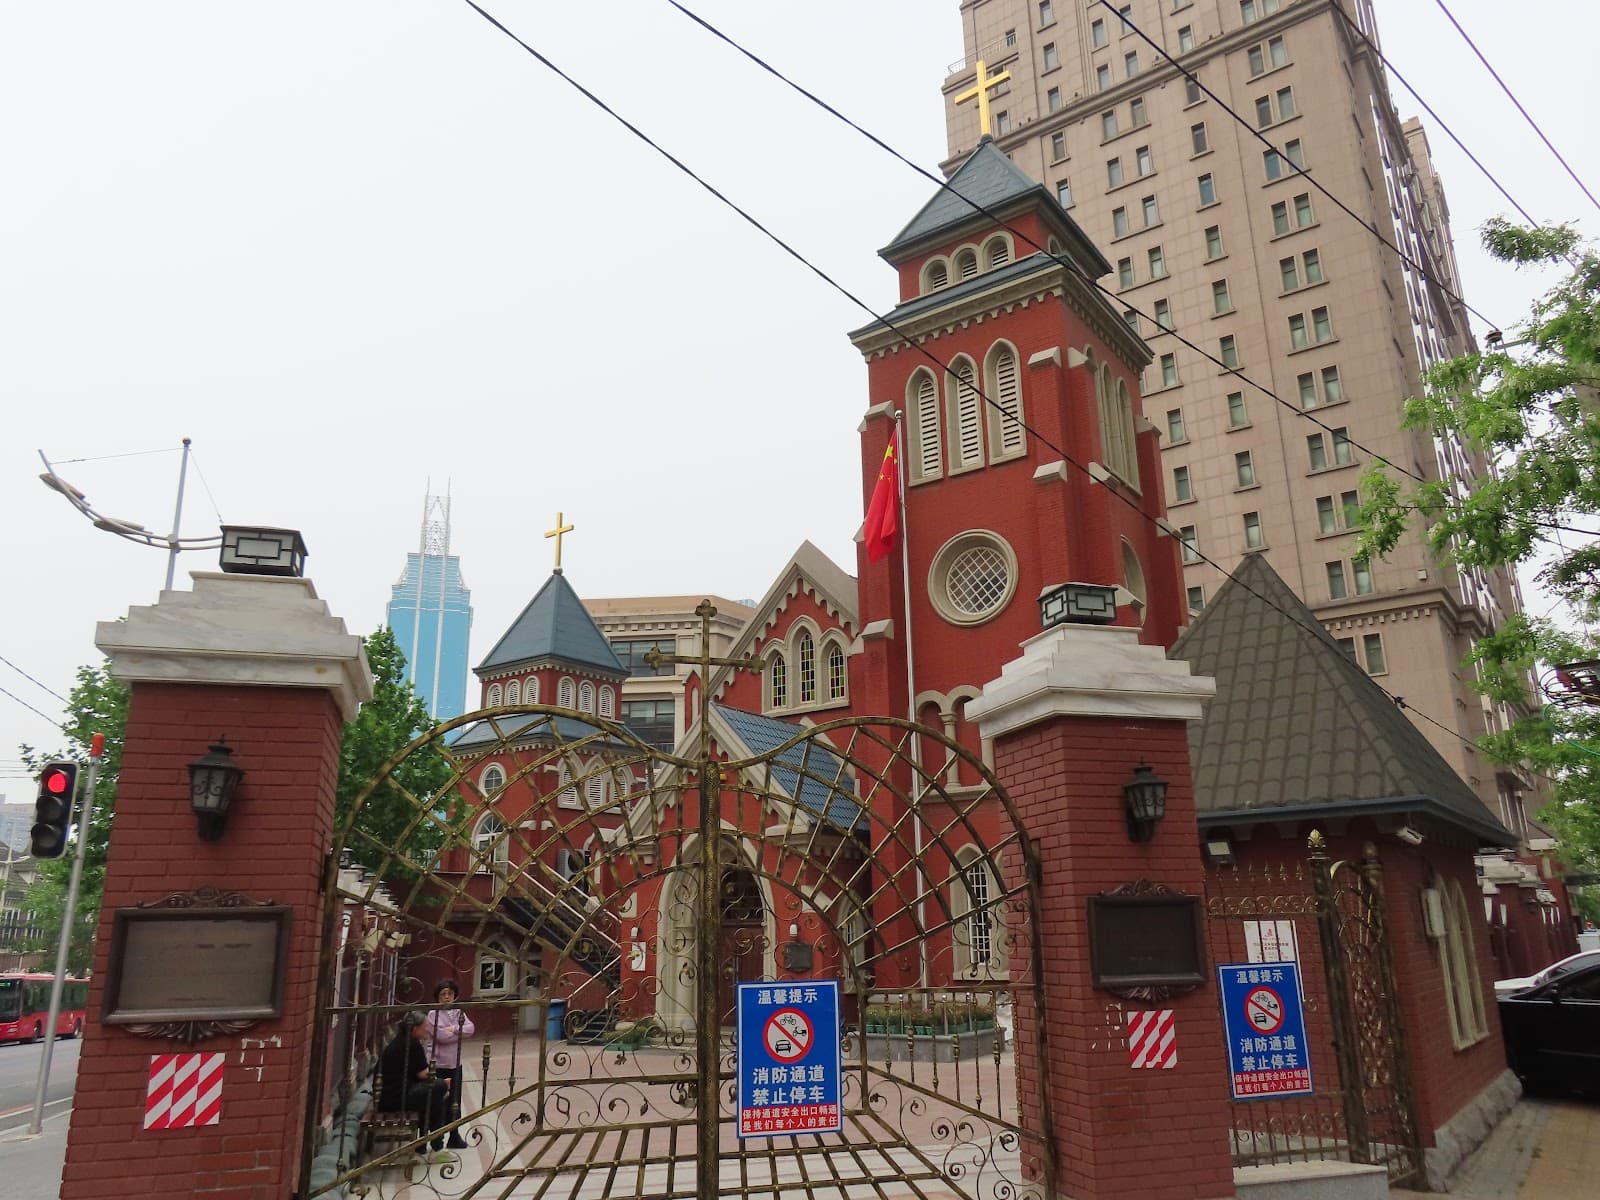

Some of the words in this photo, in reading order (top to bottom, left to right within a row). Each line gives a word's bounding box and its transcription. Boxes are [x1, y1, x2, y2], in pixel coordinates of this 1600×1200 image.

[1236, 969, 1284, 984] 温馨提示
[758, 988, 818, 1005] 温馨提示
[1240, 1035, 1297, 1053] 消防通道
[1242, 1053, 1298, 1071] 禁止停车
[752, 1065, 825, 1085] 消防通道
[752, 1085, 825, 1106] 禁止停车
[742, 1116, 838, 1131] 是我们每个人的责任
